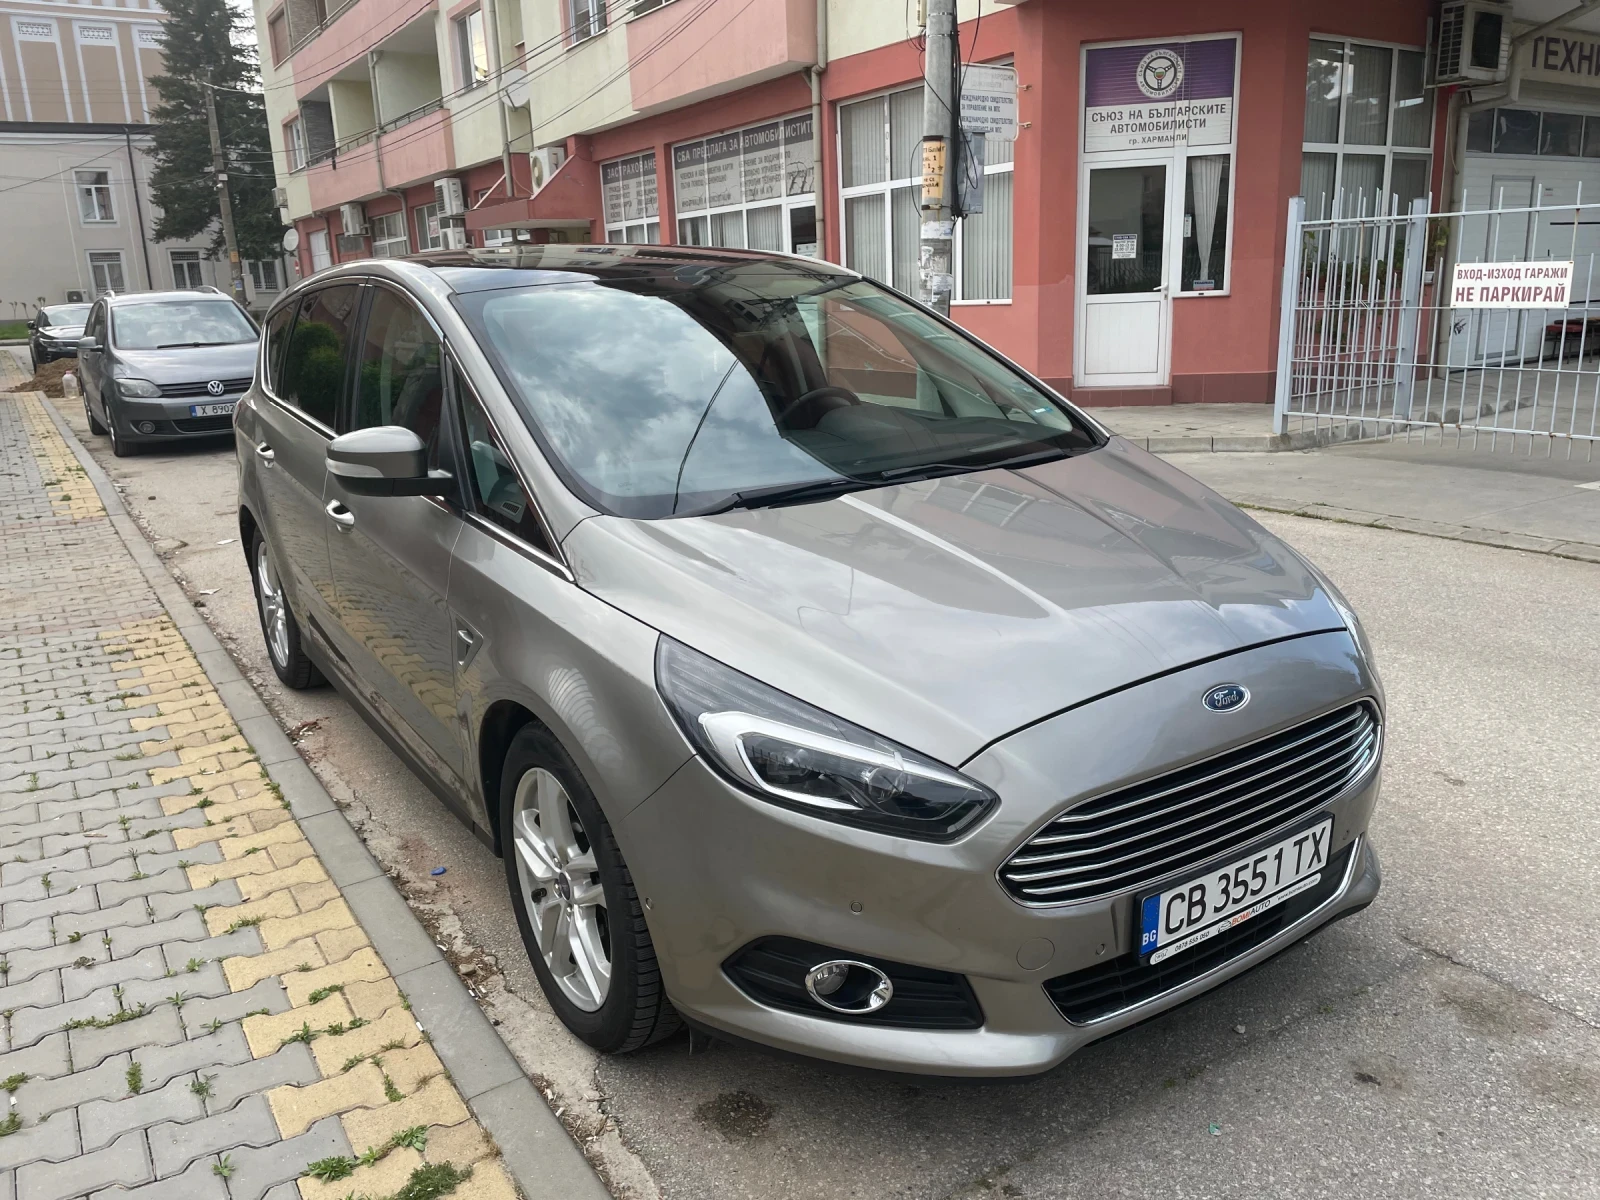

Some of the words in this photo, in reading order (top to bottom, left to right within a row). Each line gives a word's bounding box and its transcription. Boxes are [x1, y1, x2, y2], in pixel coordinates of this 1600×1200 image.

[1091, 111, 1124, 122] СЪЮЗ
[1128, 109, 1143, 120] НА
[1148, 103, 1227, 119] БЪЛГАРСКИТЕ
[1110, 118, 1206, 134] АВТОМОБИЛИСТИ
[1128, 137, 1140, 145] гр.
[1141, 133, 1187, 143] ХАРМАНЛИ
[676, 149, 691, 163] СБА
[692, 140, 728, 160] ПРЕДЛАГА
[728, 138, 739, 152] ЗА
[1457, 268, 1522, 281] ВХОД-ИЗХОД
[1524, 267, 1568, 279] ГАРАЖИ
[1455, 286, 1475, 302] НЕ
[1479, 282, 1566, 302] ПАРКИРАЙ
[212, 404, 234, 414] 8902
[1213, 689, 1240, 708] Ford
[1165, 883, 1207, 935] CB
[1213, 847, 1284, 914] 3551
[1292, 826, 1327, 876] TX
[1142, 929, 1157, 946] BG
